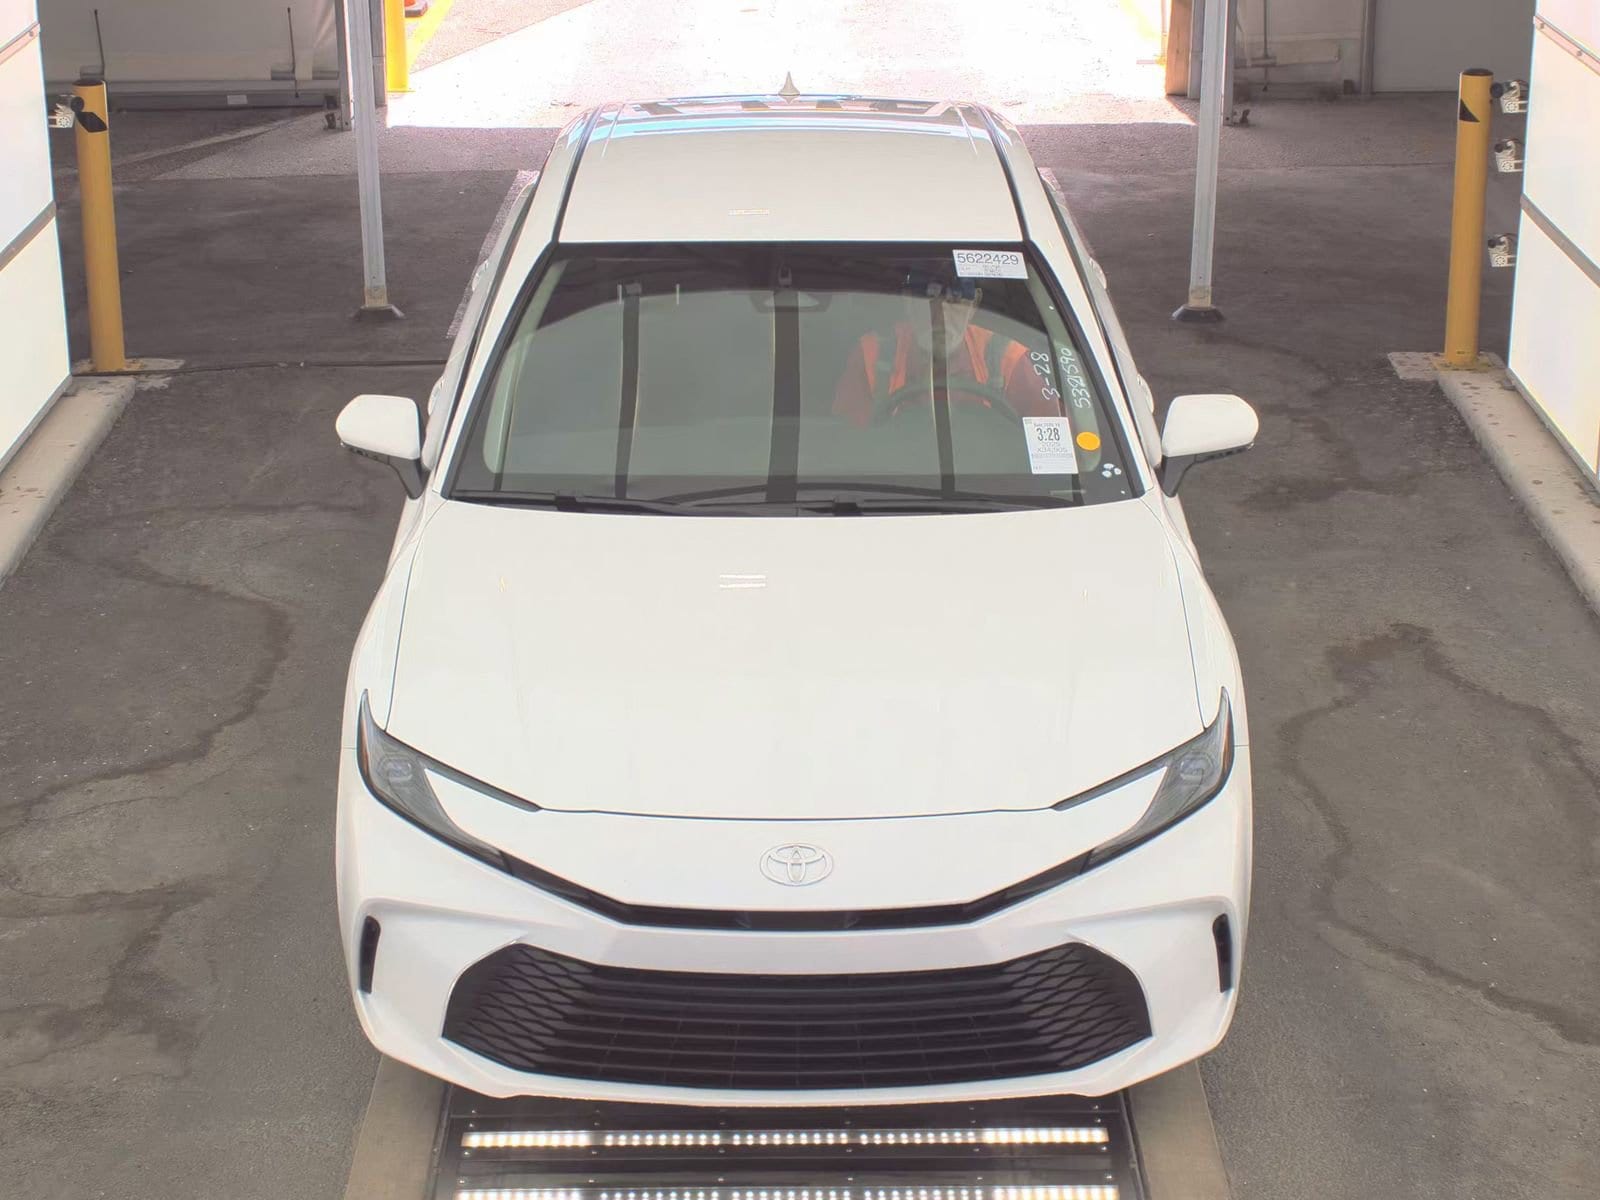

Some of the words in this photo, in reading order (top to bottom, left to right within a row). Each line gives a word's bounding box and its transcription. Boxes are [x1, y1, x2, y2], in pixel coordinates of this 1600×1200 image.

[957, 252, 1019, 265] 5622429
[1031, 351, 1060, 400] 3-28
[1036, 427, 1061, 441] 3:28
